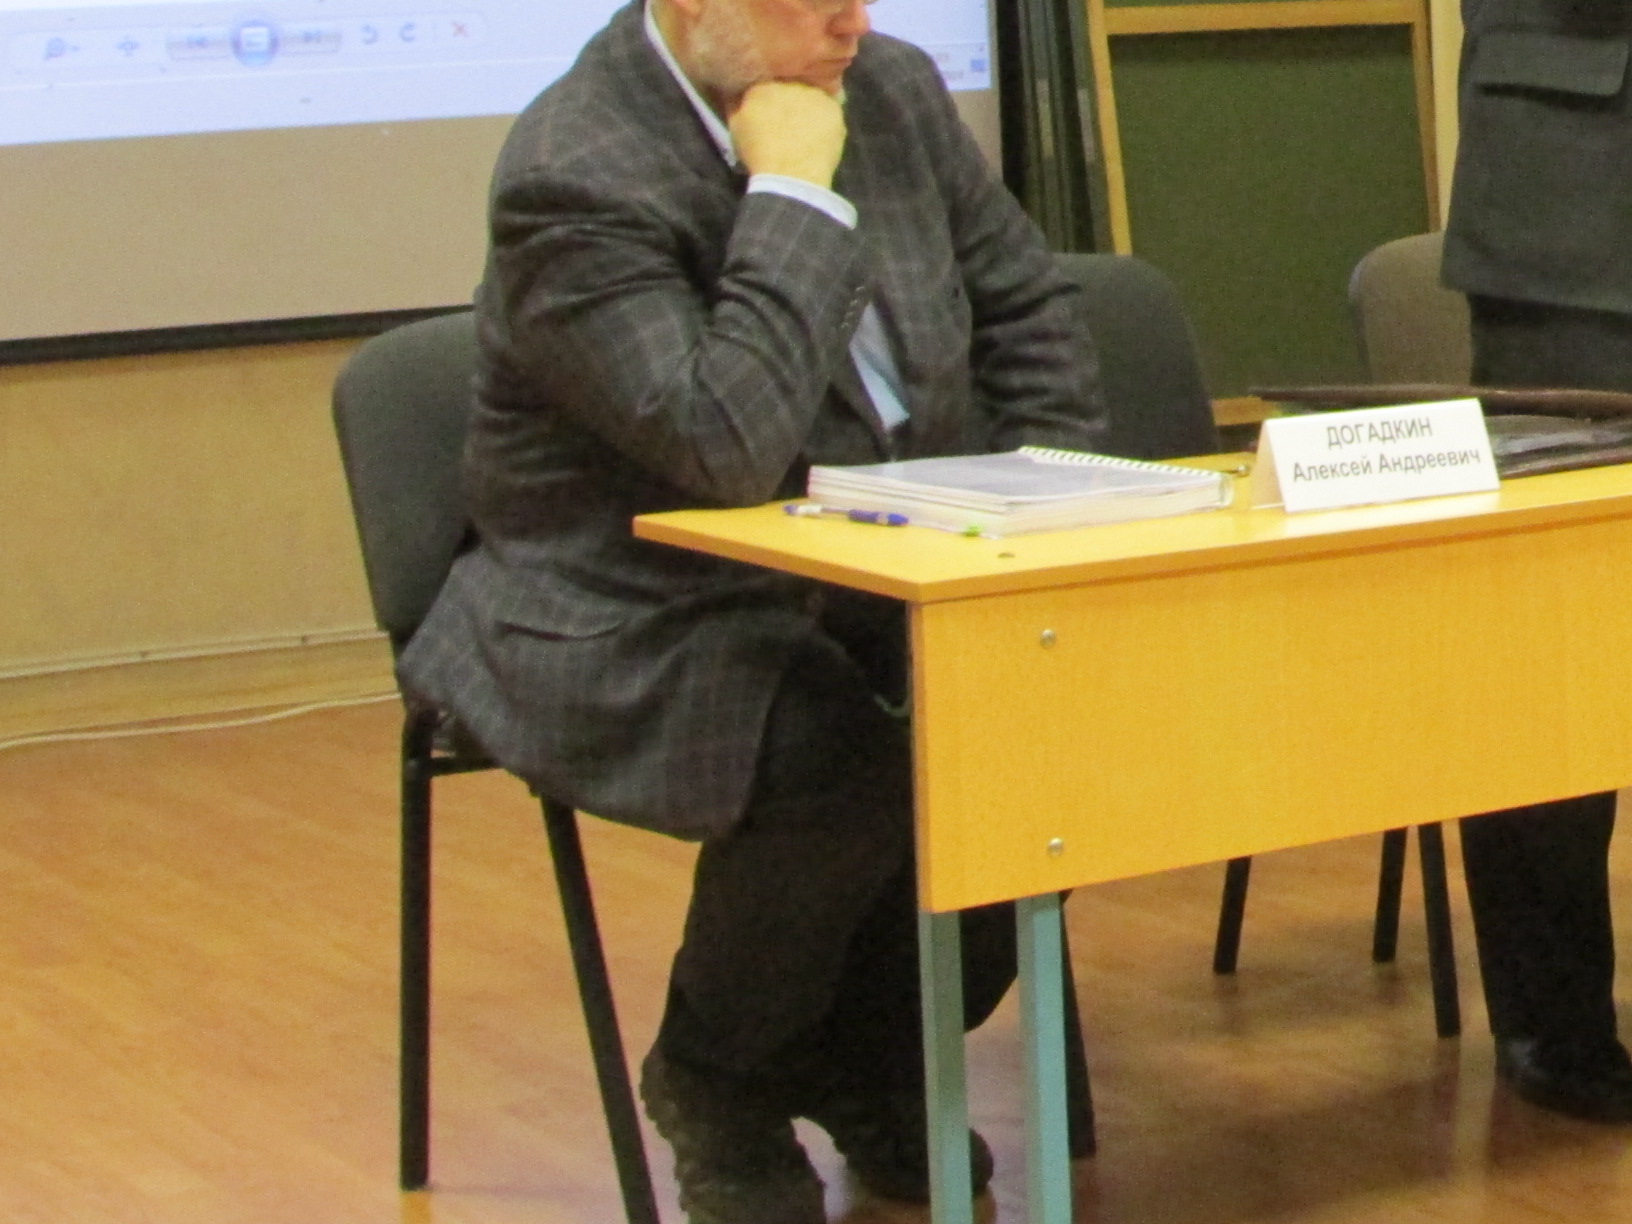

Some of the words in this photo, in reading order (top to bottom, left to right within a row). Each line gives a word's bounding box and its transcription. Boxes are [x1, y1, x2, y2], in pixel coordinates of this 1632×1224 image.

[1326, 418, 1432, 449] ДОГАДКИН
[1293, 456, 1373, 482] Алексей
[1379, 449, 1481, 474] Андреевич
